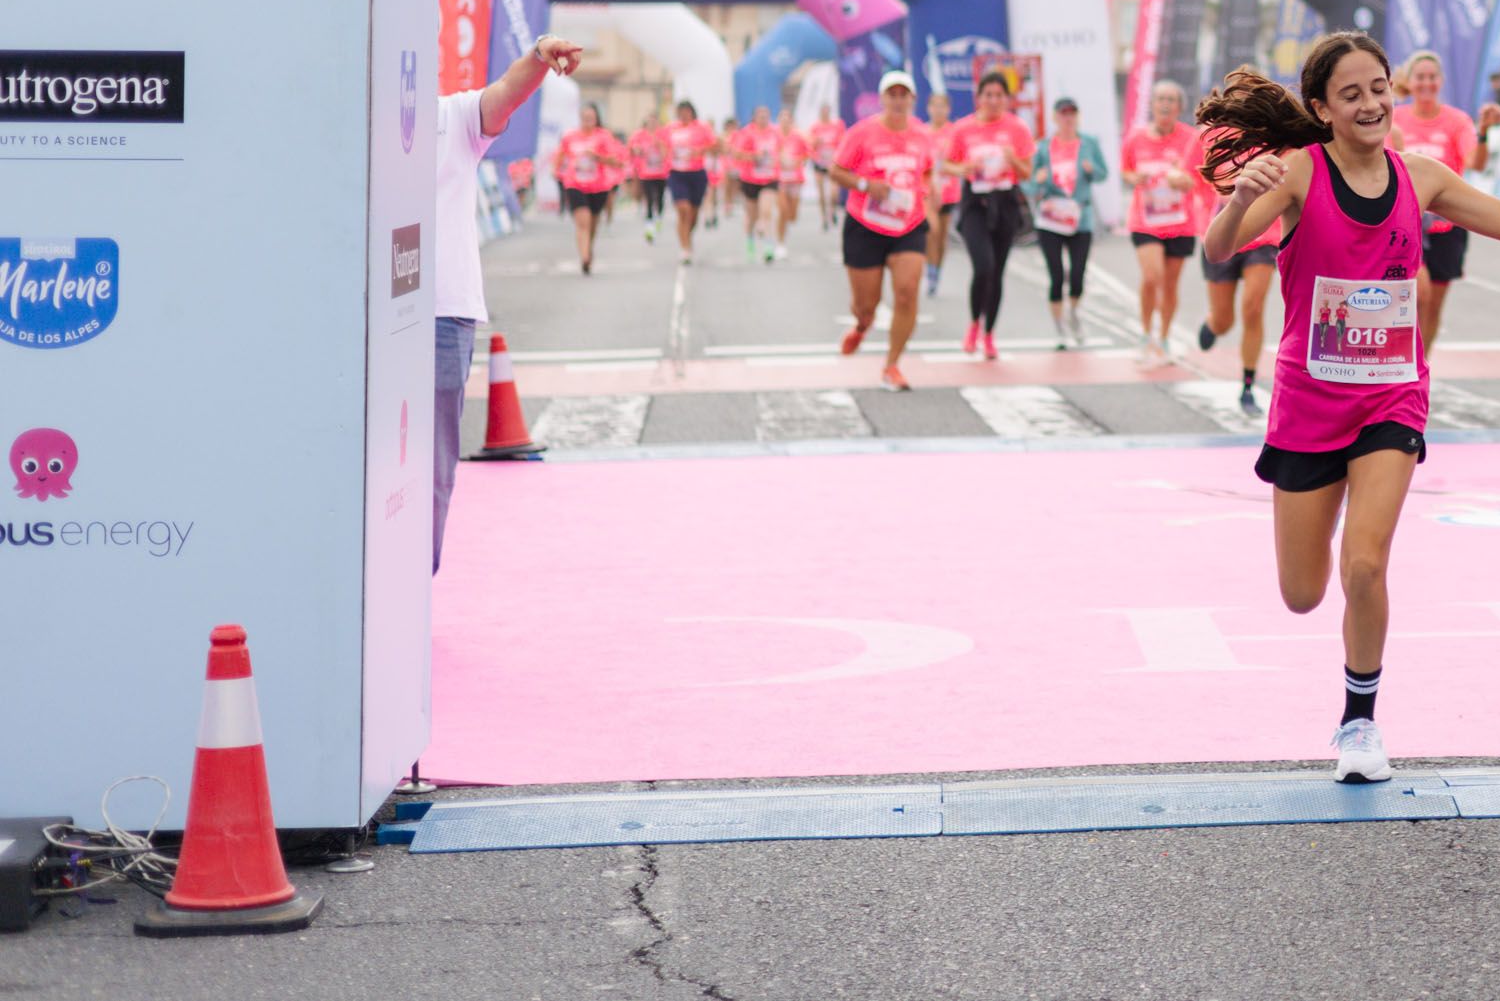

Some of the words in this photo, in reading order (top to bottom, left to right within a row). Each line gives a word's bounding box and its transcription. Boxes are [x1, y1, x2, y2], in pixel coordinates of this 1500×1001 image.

[31, 135, 49, 147] TO
[54, 135, 62, 146] A
[67, 135, 128, 147] SCIENCE
[19, 330, 34, 343] DE
[38, 333, 61, 344] LOS
[64, 319, 100, 342] ALPES
[1346, 328, 1388, 346] 016
[1319, 366, 1356, 377] OYSHO
